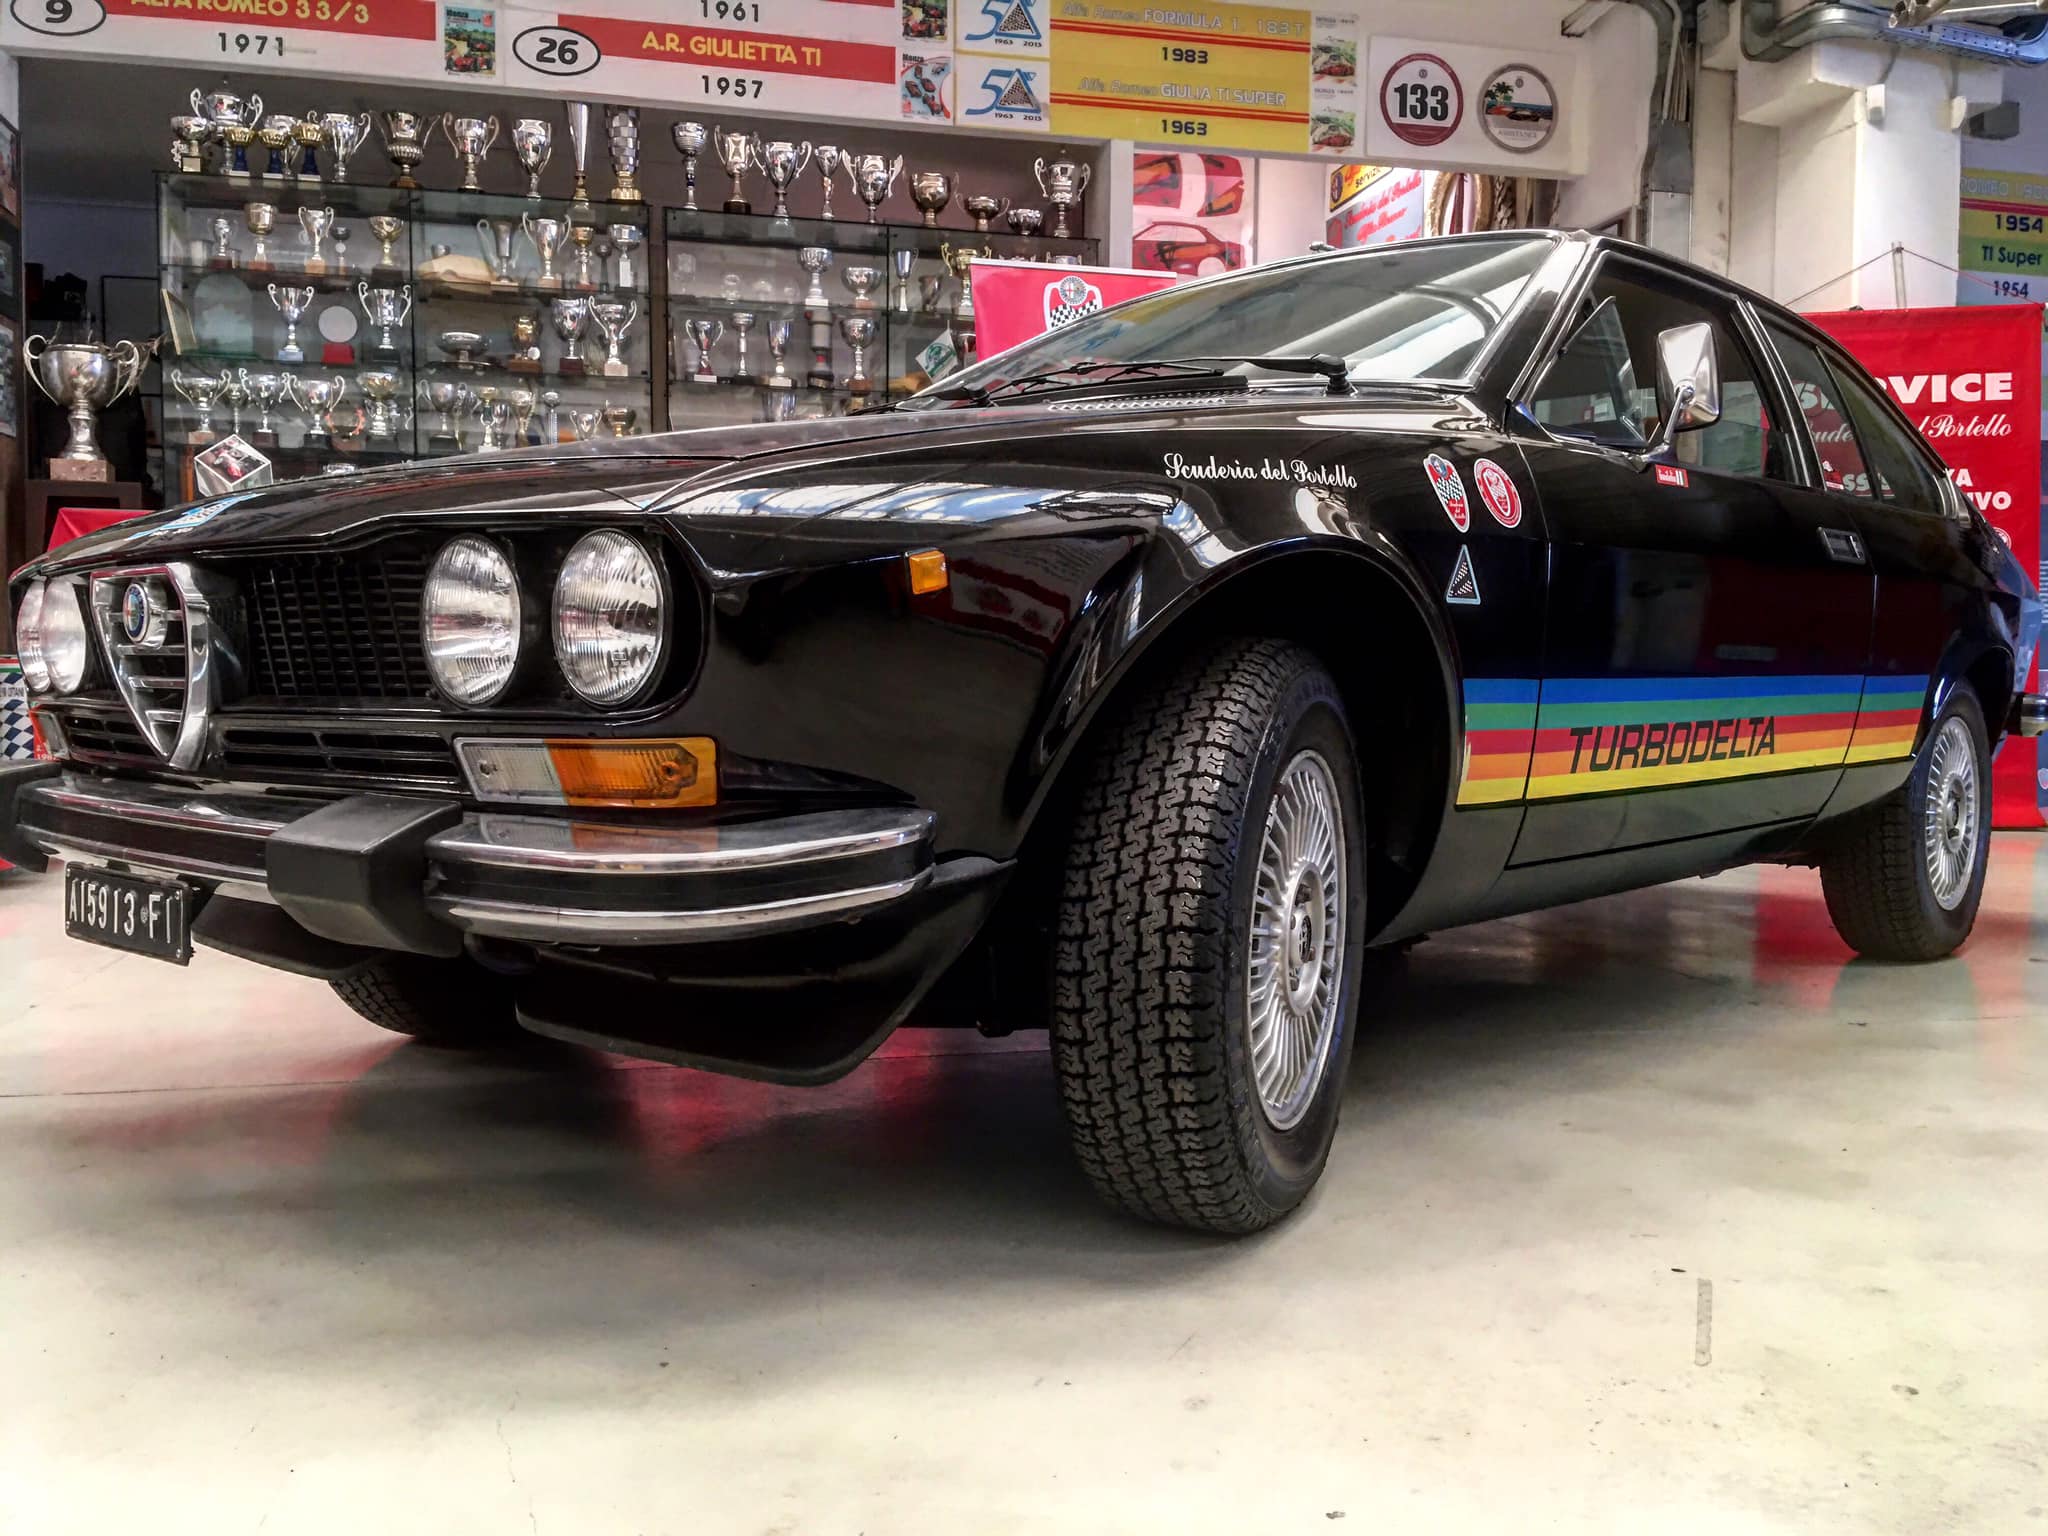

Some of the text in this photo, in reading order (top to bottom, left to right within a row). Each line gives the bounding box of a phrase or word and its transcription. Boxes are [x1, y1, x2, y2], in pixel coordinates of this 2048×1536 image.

[45, 0, 73, 23] 9
[196, 0, 288, 16] ROMEO
[700, 0, 759, 22] 1961
[1143, 8, 1222, 29] FORMULA
[218, 32, 284, 56] 1971
[536, 37, 578, 65] 26
[642, 31, 821, 67] A.R. GIULIETTA TI
[994, 38, 1014, 46] 1963
[1162, 46, 1209, 64] 1983
[701, 75, 763, 98] 1957
[1161, 82, 1212, 101] GIULIA
[1233, 89, 1287, 108] SUPER
[1393, 83, 1449, 122] 133
[994, 112, 1014, 120] 1963
[1161, 119, 1208, 136] 1963
[1994, 214, 2043, 234] 1954
[1981, 245, 2043, 268] TI Super
[1993, 280, 2029, 298] 1954
[1927, 413, 2012, 438] Portello
[1164, 453, 1358, 489] Scuderia del Portello
[1570, 715, 1775, 774] TURBODELTA
